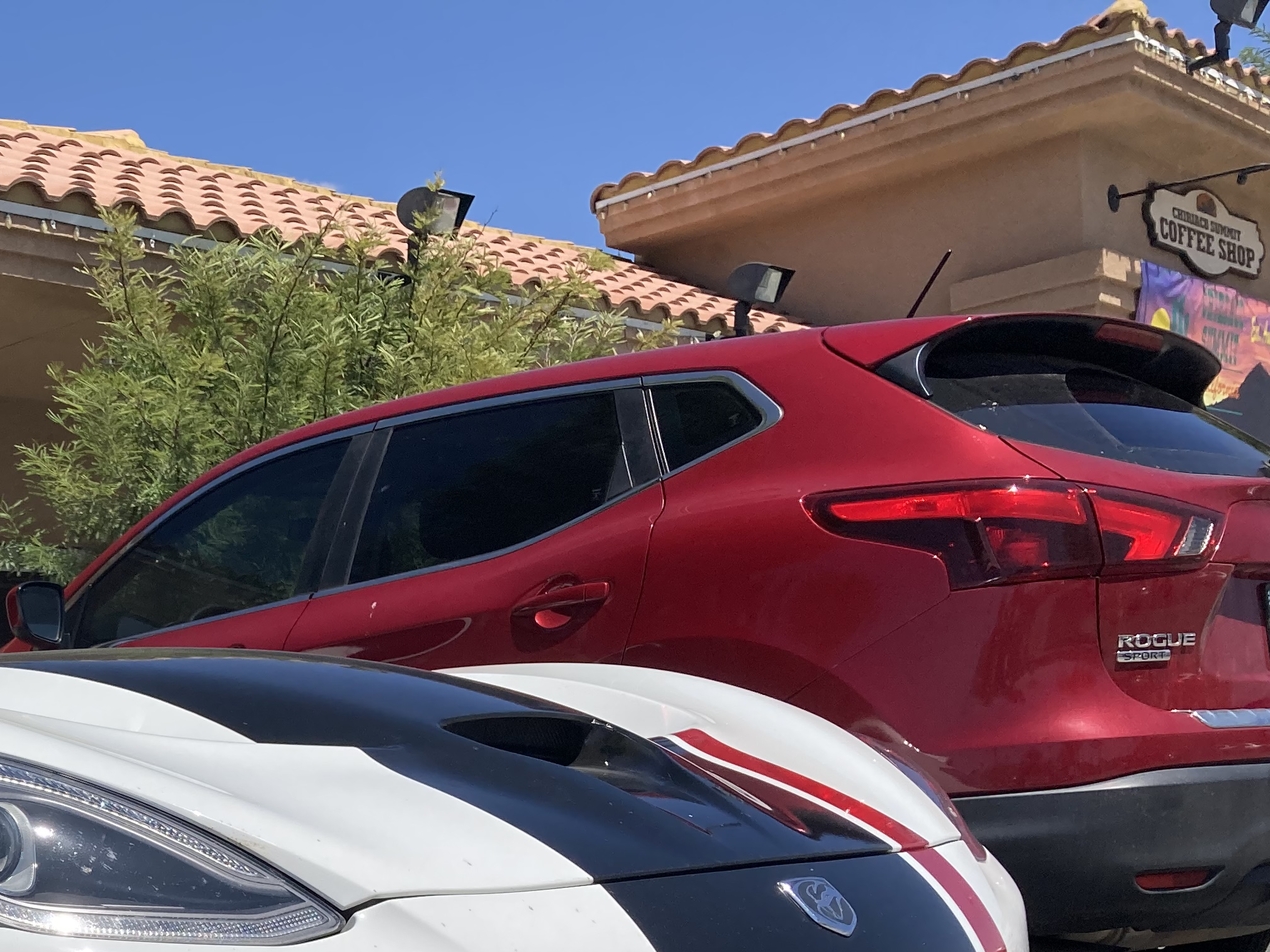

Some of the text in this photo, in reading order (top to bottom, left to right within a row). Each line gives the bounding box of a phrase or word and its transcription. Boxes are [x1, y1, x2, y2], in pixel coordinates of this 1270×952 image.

[1210, 221, 1241, 241] SUMMIT
[1159, 216, 1255, 268] COFFEE SHOP
[1117, 632, 1197, 649] ROGUE
[1124, 650, 1166, 661] SPORT
